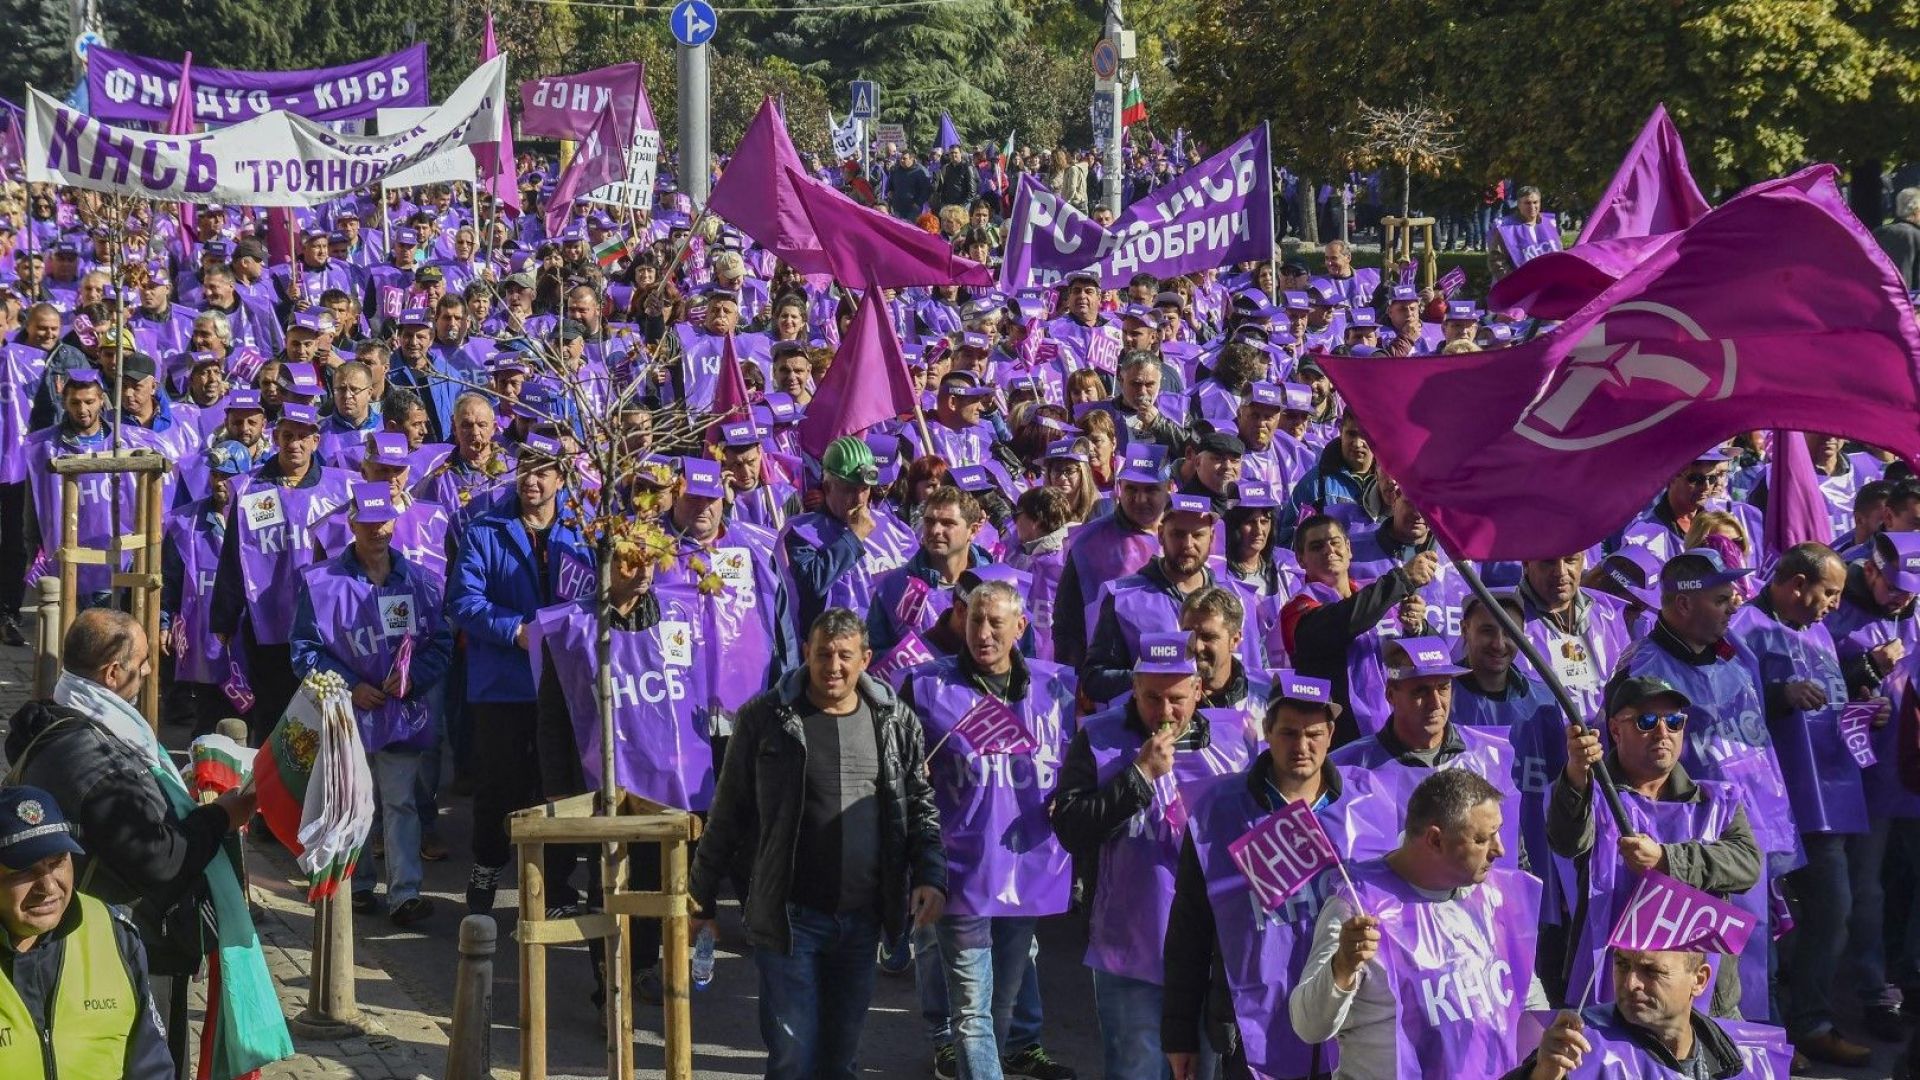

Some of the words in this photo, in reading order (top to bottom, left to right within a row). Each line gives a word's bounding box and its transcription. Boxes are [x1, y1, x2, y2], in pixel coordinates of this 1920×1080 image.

[313, 65, 410, 110] КНСБ
[47, 107, 218, 193] КНСБ
[1023, 189, 1088, 255] РС
[1111, 210, 1250, 277] ДОБРИЧ
[1087, 331, 1119, 373] КНСБ
[1132, 458, 1154, 468] КНСБ
[692, 473, 713, 483] КНСБ
[1245, 487, 1265, 497] КНСБ
[364, 498, 385, 508] КНСБ
[1180, 500, 1204, 509] КНСБ
[1609, 568, 1632, 588] КНСБ
[1677, 580, 1703, 592] КНСБ
[1150, 646, 1178, 657] КНСБ
[1418, 650, 1444, 662] КНСБ
[592, 669, 685, 711] НСБ
[1292, 684, 1321, 697] КНСБ
[956, 700, 1034, 755] КНСБ
[1849, 703, 1882, 768] КНСБ
[953, 751, 1058, 789] КНСБ
[1235, 807, 1335, 905] КНСБ
[83, 998, 118, 1011] POLICE
